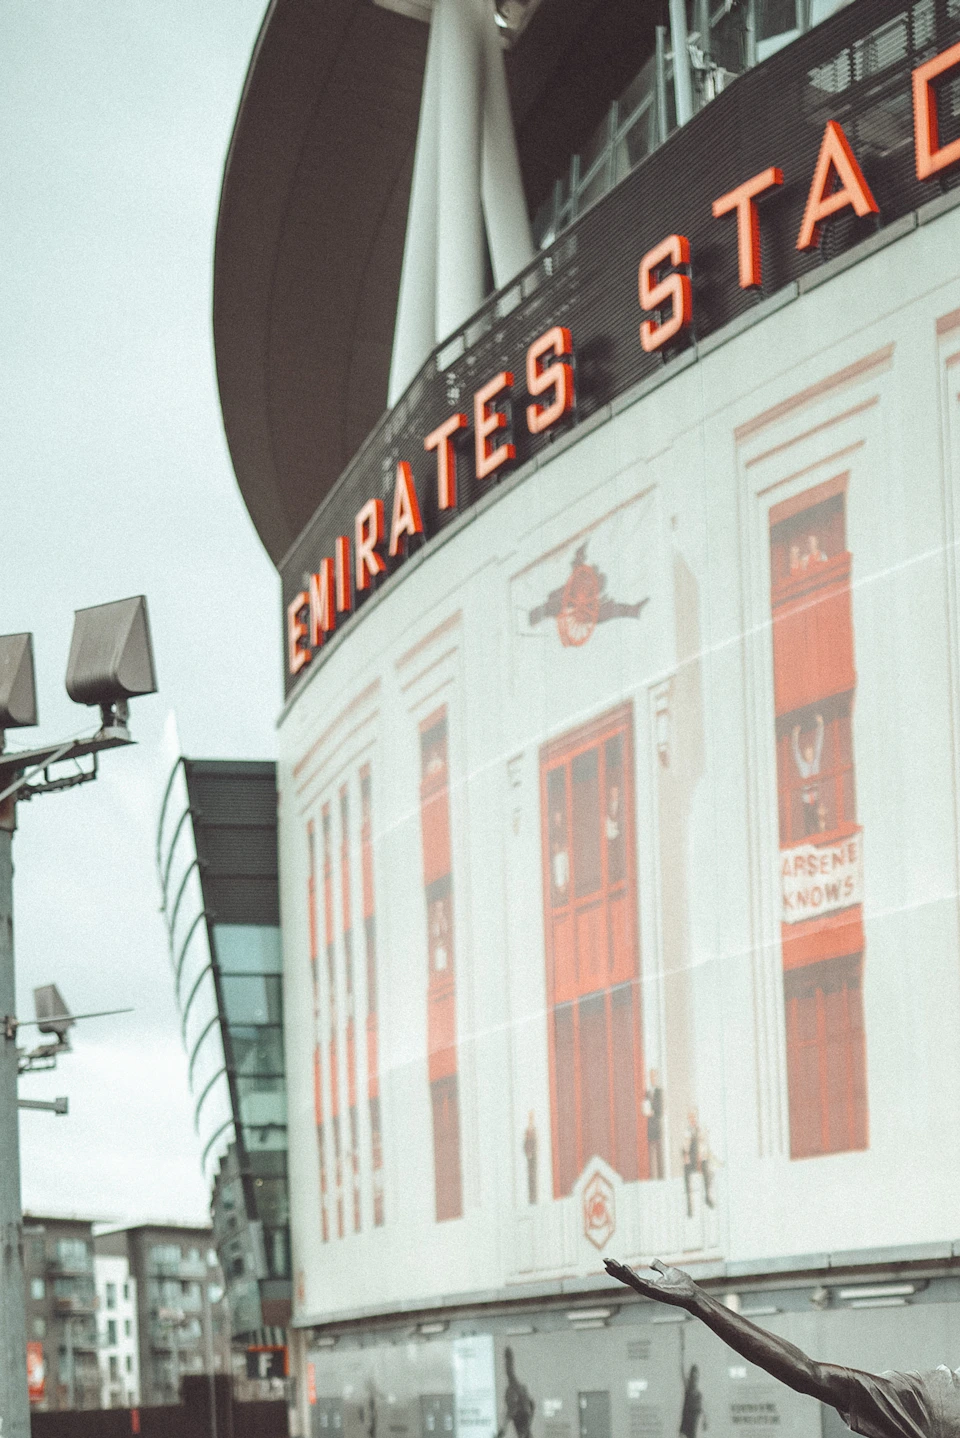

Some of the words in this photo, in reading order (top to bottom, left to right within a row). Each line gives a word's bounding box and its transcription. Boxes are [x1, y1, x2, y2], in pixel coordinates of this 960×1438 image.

[287, 325, 575, 675] EMIRATES
[782, 842, 857, 877] ARSENE
[783, 876, 855, 910] KNOWS
